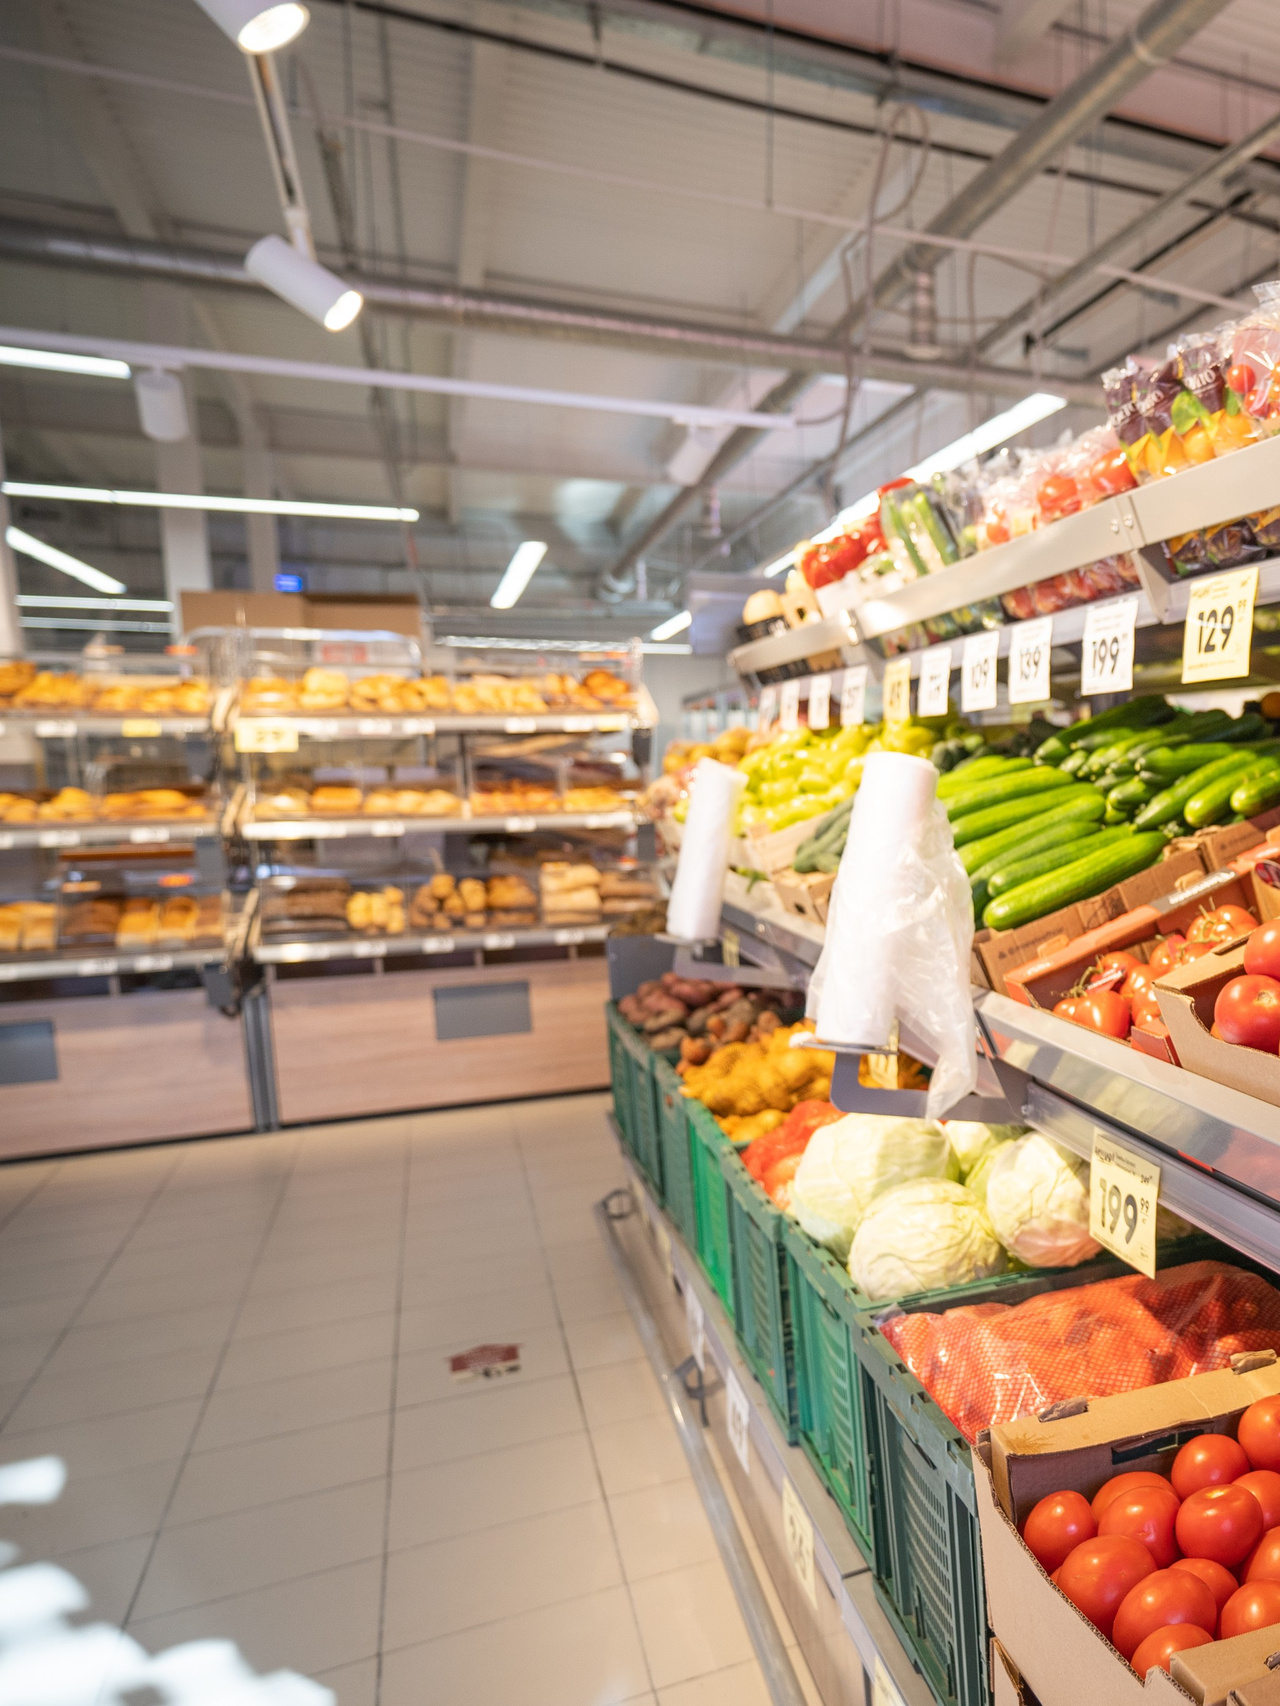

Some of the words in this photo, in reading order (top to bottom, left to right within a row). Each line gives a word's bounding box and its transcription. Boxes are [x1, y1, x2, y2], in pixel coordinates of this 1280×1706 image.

[1198, 605, 1234, 654] 129
[1092, 636, 1119, 677] 199
[1100, 1177, 1138, 1244] 199
[1140, 1197, 1149, 1213] 99
